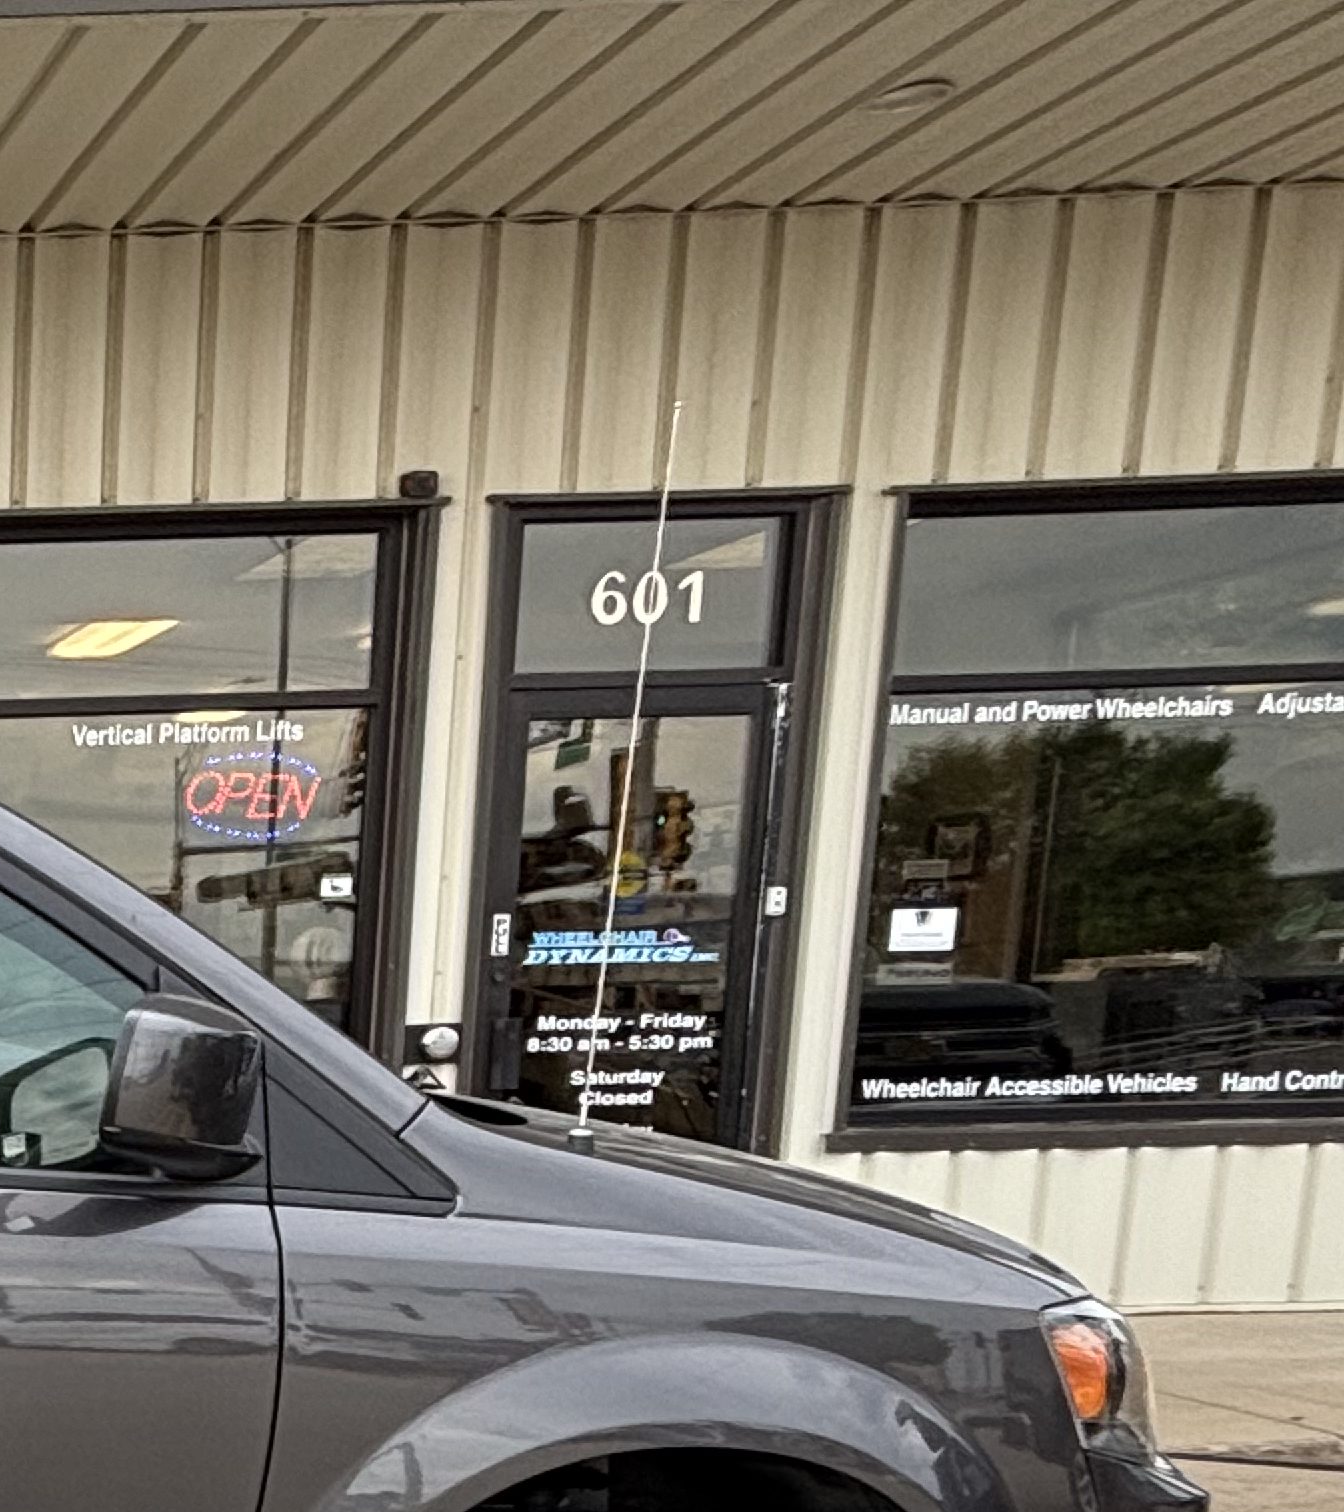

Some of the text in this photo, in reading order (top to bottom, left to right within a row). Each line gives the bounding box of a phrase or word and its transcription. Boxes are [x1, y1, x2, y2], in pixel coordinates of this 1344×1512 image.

[591, 570, 704, 625] 601
[889, 695, 1234, 725] Manual and Power Wheelchairs
[72, 718, 304, 746] Vertical Platform Lifts
[184, 771, 322, 820] OPEN
[532, 930, 658, 945] WHEELCHAIR
[522, 945, 695, 965] DYNAMICS
[537, 1014, 622, 1034] Monday
[640, 1013, 708, 1032] Friday
[526, 1036, 574, 1053] 8:30
[576, 1038, 611, 1052] am
[628, 1034, 675, 1050] 5:30
[678, 1036, 714, 1053] pm
[570, 1069, 665, 1087] Saturday
[862, 1072, 1199, 1099] Wheelchair Accessible Vehicles
[1221, 1070, 1281, 1092] Hand
[579, 1090, 654, 1106] Closed
